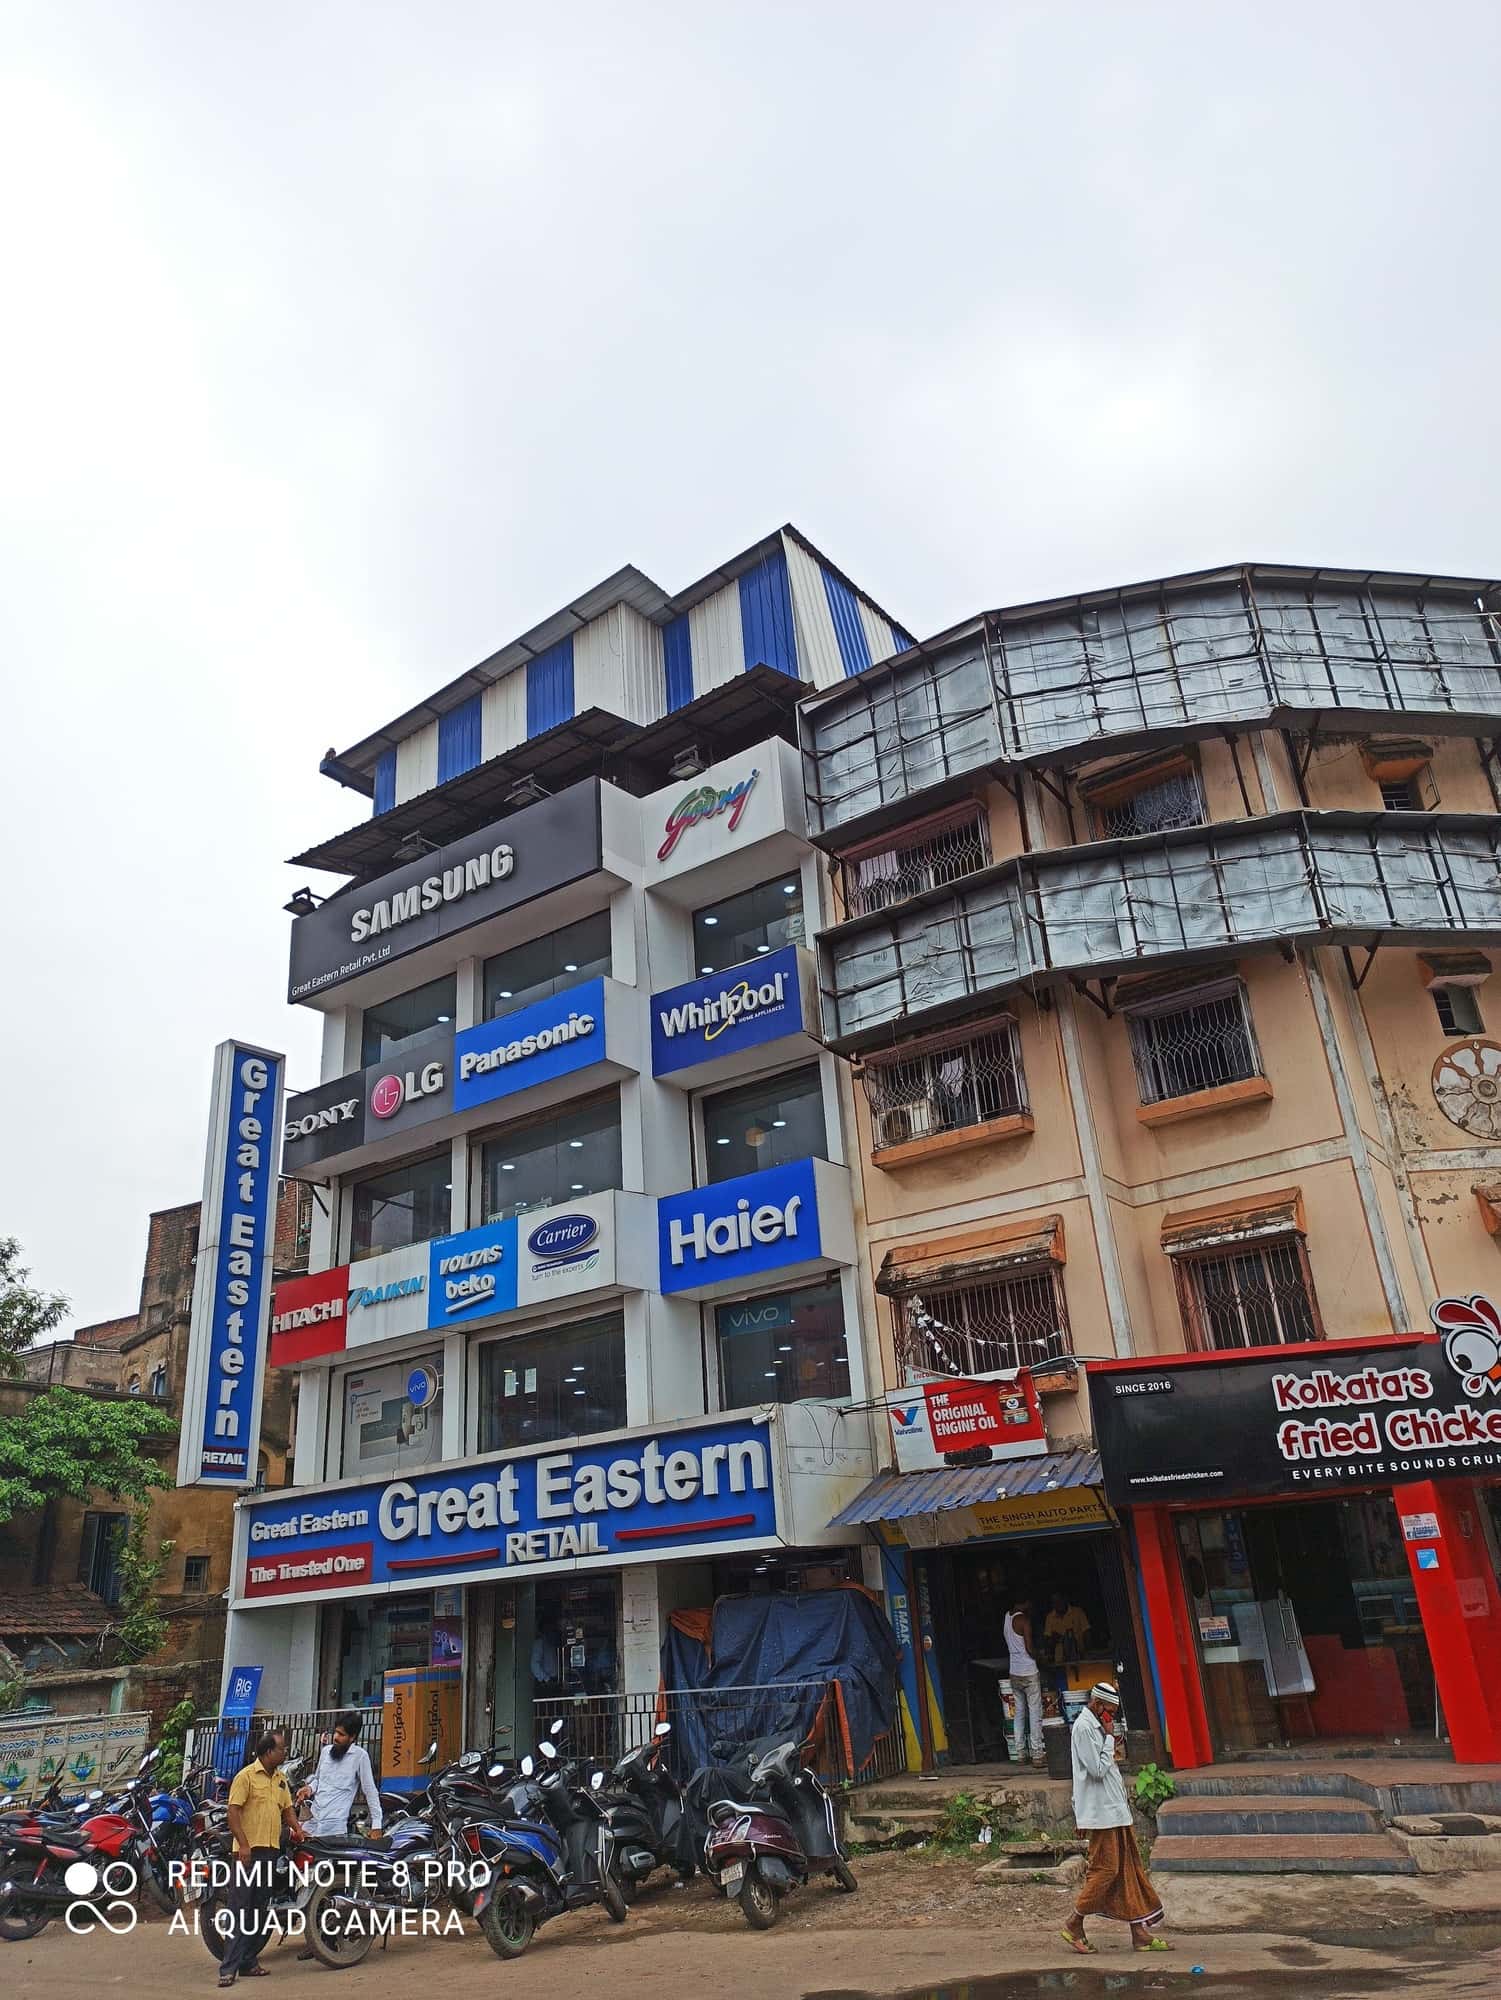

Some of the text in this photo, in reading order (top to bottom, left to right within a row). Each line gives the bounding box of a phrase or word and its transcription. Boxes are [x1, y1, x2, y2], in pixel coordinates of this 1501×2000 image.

[351, 844, 514, 942] SAMSUNG
[291, 944, 391, 996] Great Eastern Retail Pvt. Ltd
[660, 972, 784, 1037] Whirlpool
[754, 1003, 785, 1018] APPLIANCES
[460, 1012, 595, 1080] Panasonic
[404, 1062, 444, 1102] LG
[284, 1098, 360, 1141] SONY
[536, 1224, 587, 1247] Carrier
[669, 1195, 801, 1265] Haier
[214, 1058, 268, 1437] Great Eastern
[439, 1244, 503, 1276] VOLTAS
[360, 1275, 426, 1309] DAIKIN
[445, 1273, 496, 1300] beko
[271, 1298, 344, 1334] HITACHI
[731, 1307, 780, 1328] vivo
[930, 1394, 949, 1408] THE
[1115, 1381, 1172, 1394] SINCE 2016
[1272, 1367, 1434, 1411] Kolkata's
[933, 1402, 988, 1423] ORIGINAL
[935, 1416, 999, 1437] ENGINE OIL
[1277, 1412, 1382, 1461] fried
[202, 1451, 246, 1466] RETAIL
[1292, 1466, 1344, 1480] EVERY
[1349, 1463, 1386, 1475] BITE
[1390, 1456, 1457, 1472] SOUNDS
[378, 1438, 770, 1541] Great Eastern
[251, 1510, 369, 1541] Great Eastern
[978, 1514, 1001, 1526] THE
[1002, 1511, 1036, 1521] SINGH
[1038, 1507, 1068, 1518] AUTO
[1070, 1502, 1107, 1514] PARTS
[505, 1522, 608, 1564] RETAIL
[250, 1556, 365, 1584] The Trusted One
[236, 1678, 253, 1692] BIG
[393, 1693, 403, 1768] Whirlpool
